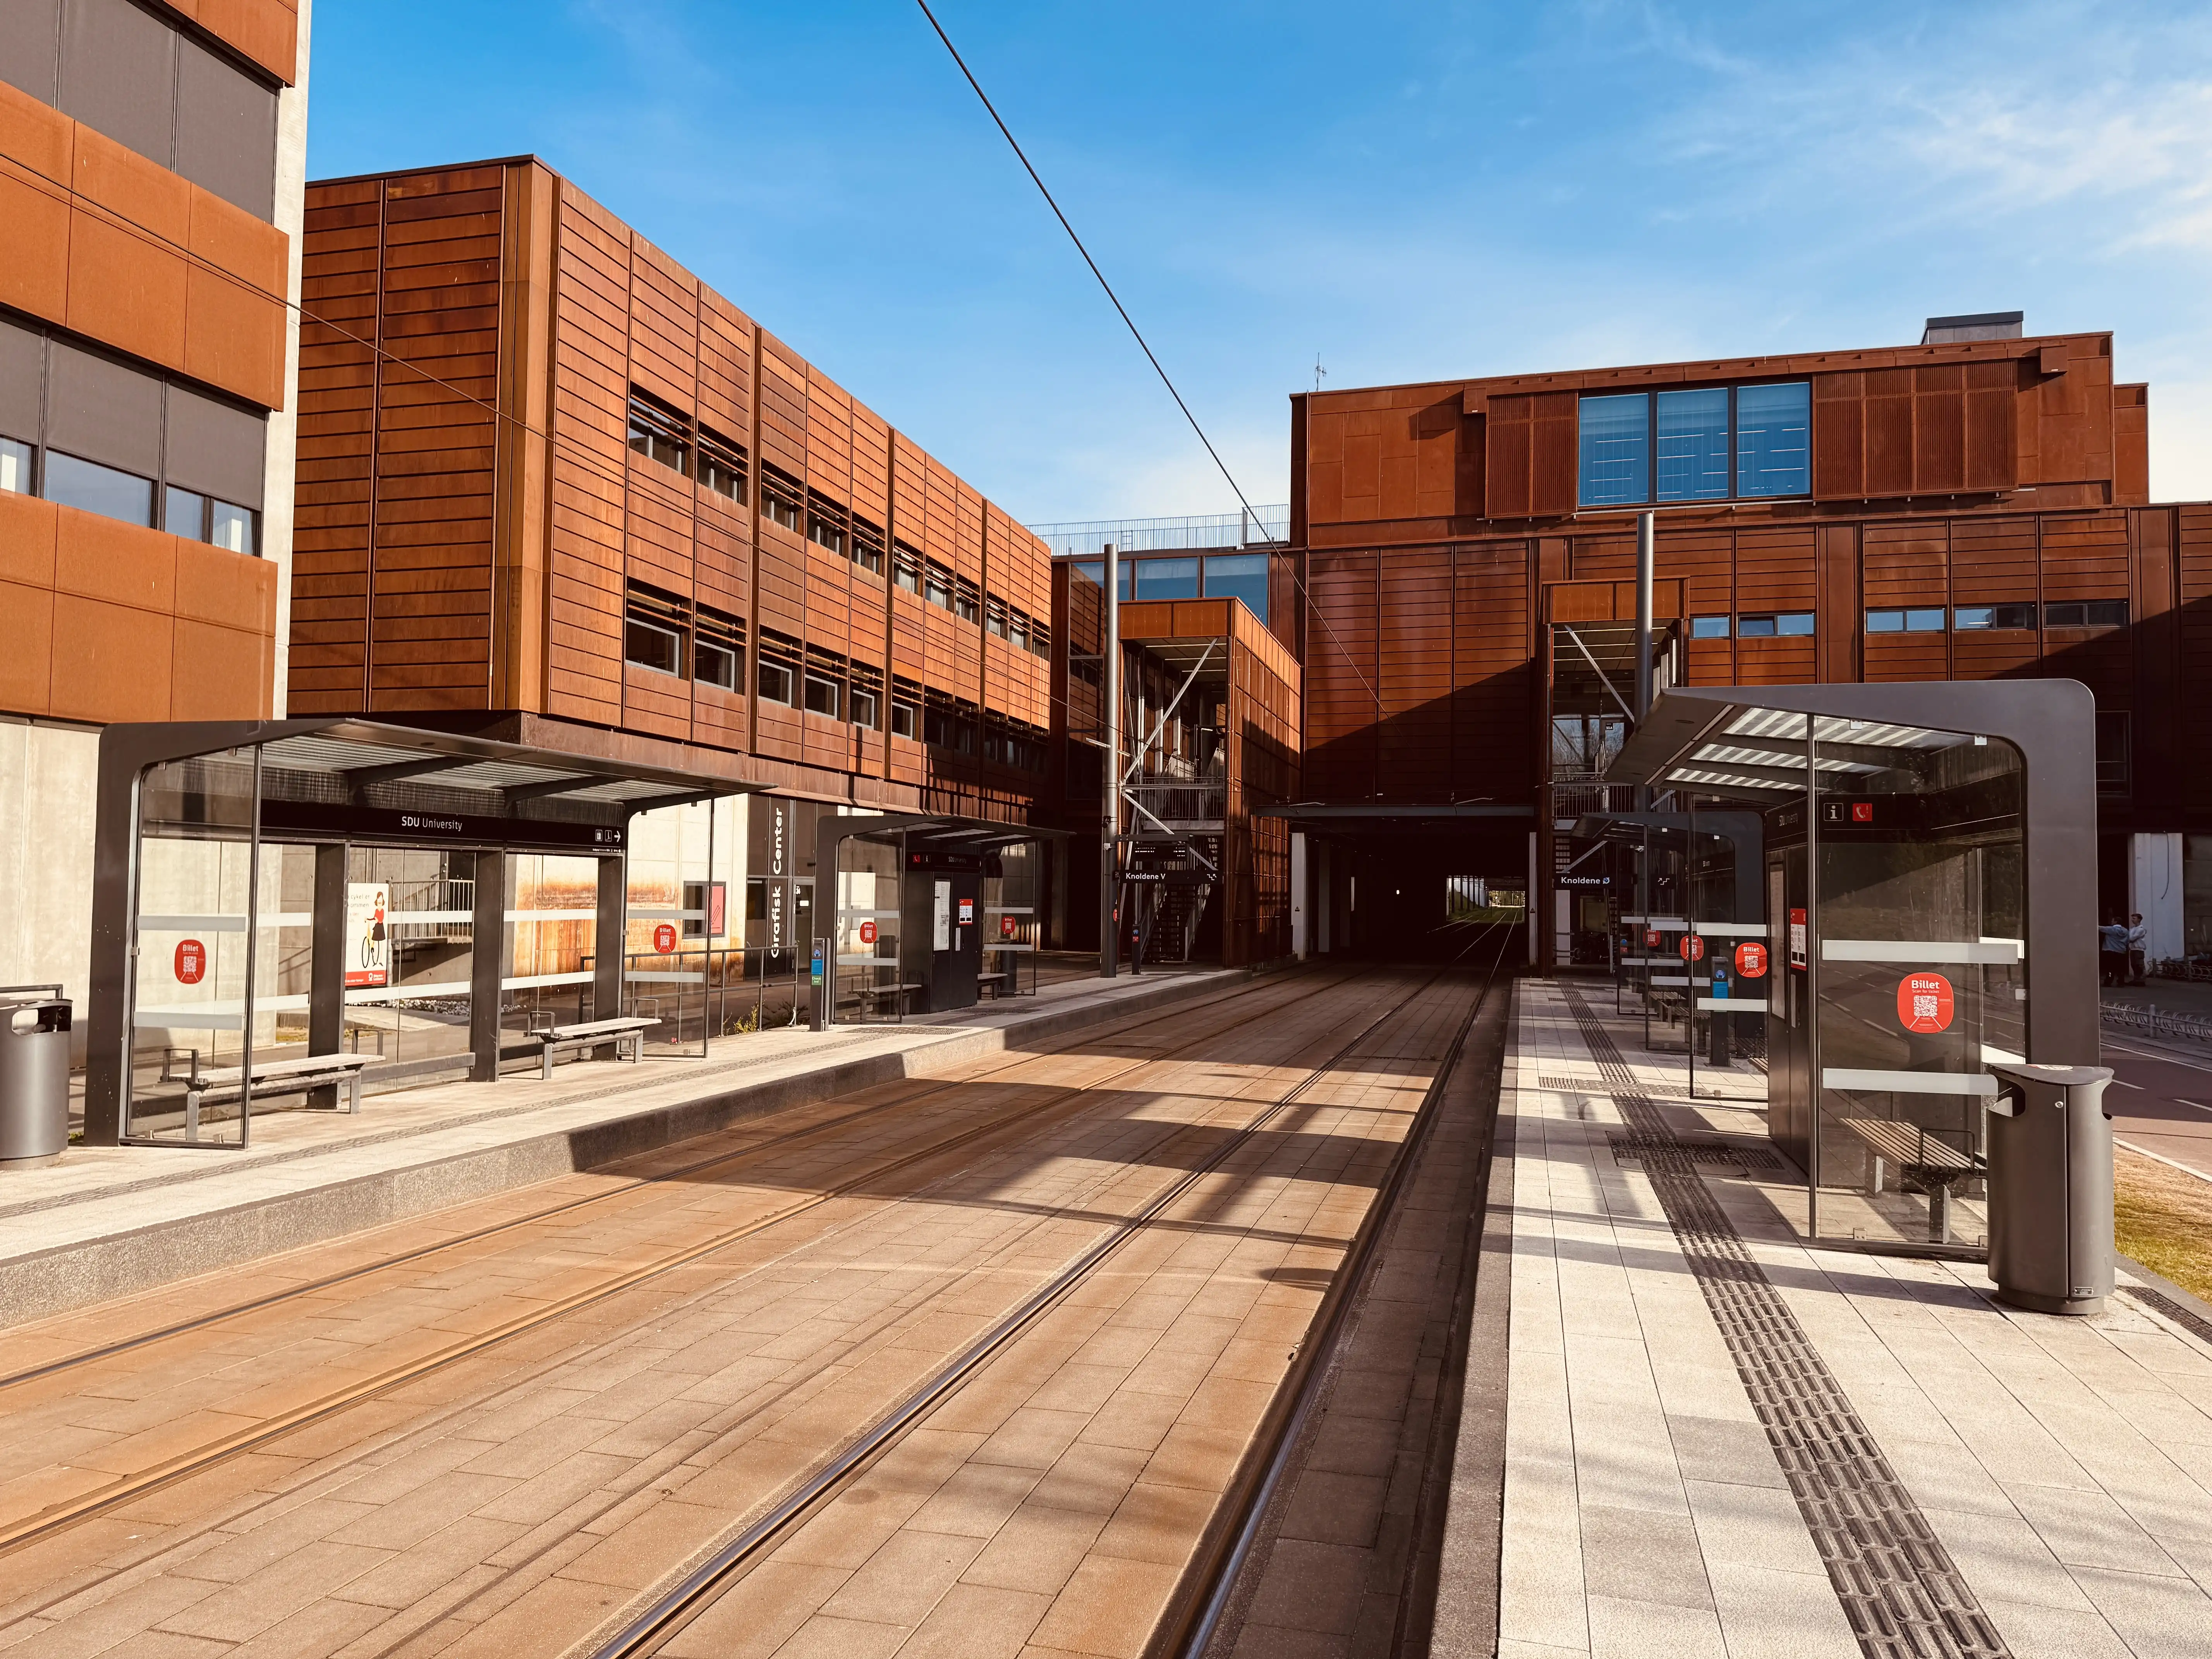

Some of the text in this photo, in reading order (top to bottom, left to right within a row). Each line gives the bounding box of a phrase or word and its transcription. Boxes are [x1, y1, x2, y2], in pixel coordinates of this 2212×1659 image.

[402, 816, 462, 831] SDU University
[771, 807, 782, 958] Grafisk Center
[1911, 980, 1940, 989] Billet
